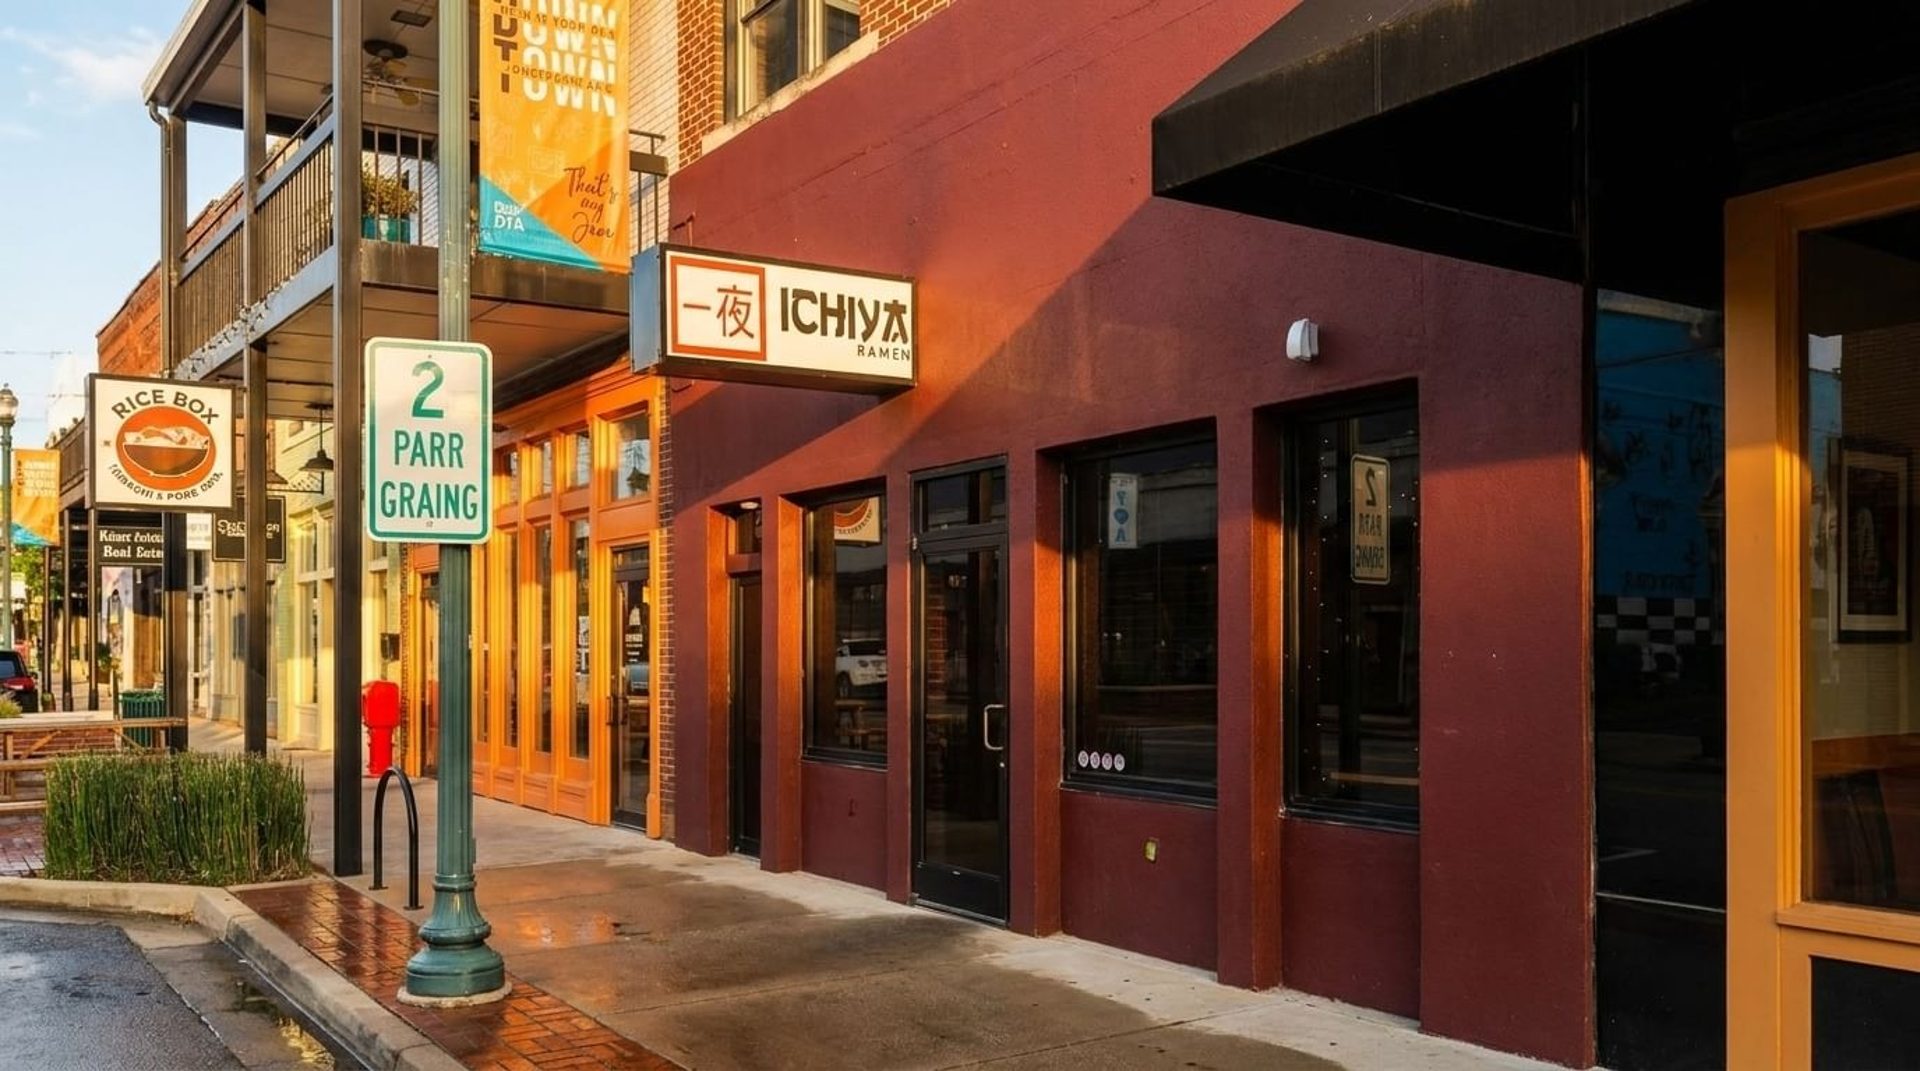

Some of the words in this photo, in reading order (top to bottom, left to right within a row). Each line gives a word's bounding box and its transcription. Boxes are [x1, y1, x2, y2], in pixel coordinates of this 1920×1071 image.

[682, 285, 754, 339] 一夜
[780, 286, 909, 344] ICHIYA
[857, 345, 911, 361] RAMEN
[111, 389, 166, 419] RICE
[173, 391, 219, 424] BOX
[411, 361, 444, 418] 2
[394, 429, 464, 469] PARR
[380, 480, 478, 520] GRAING
